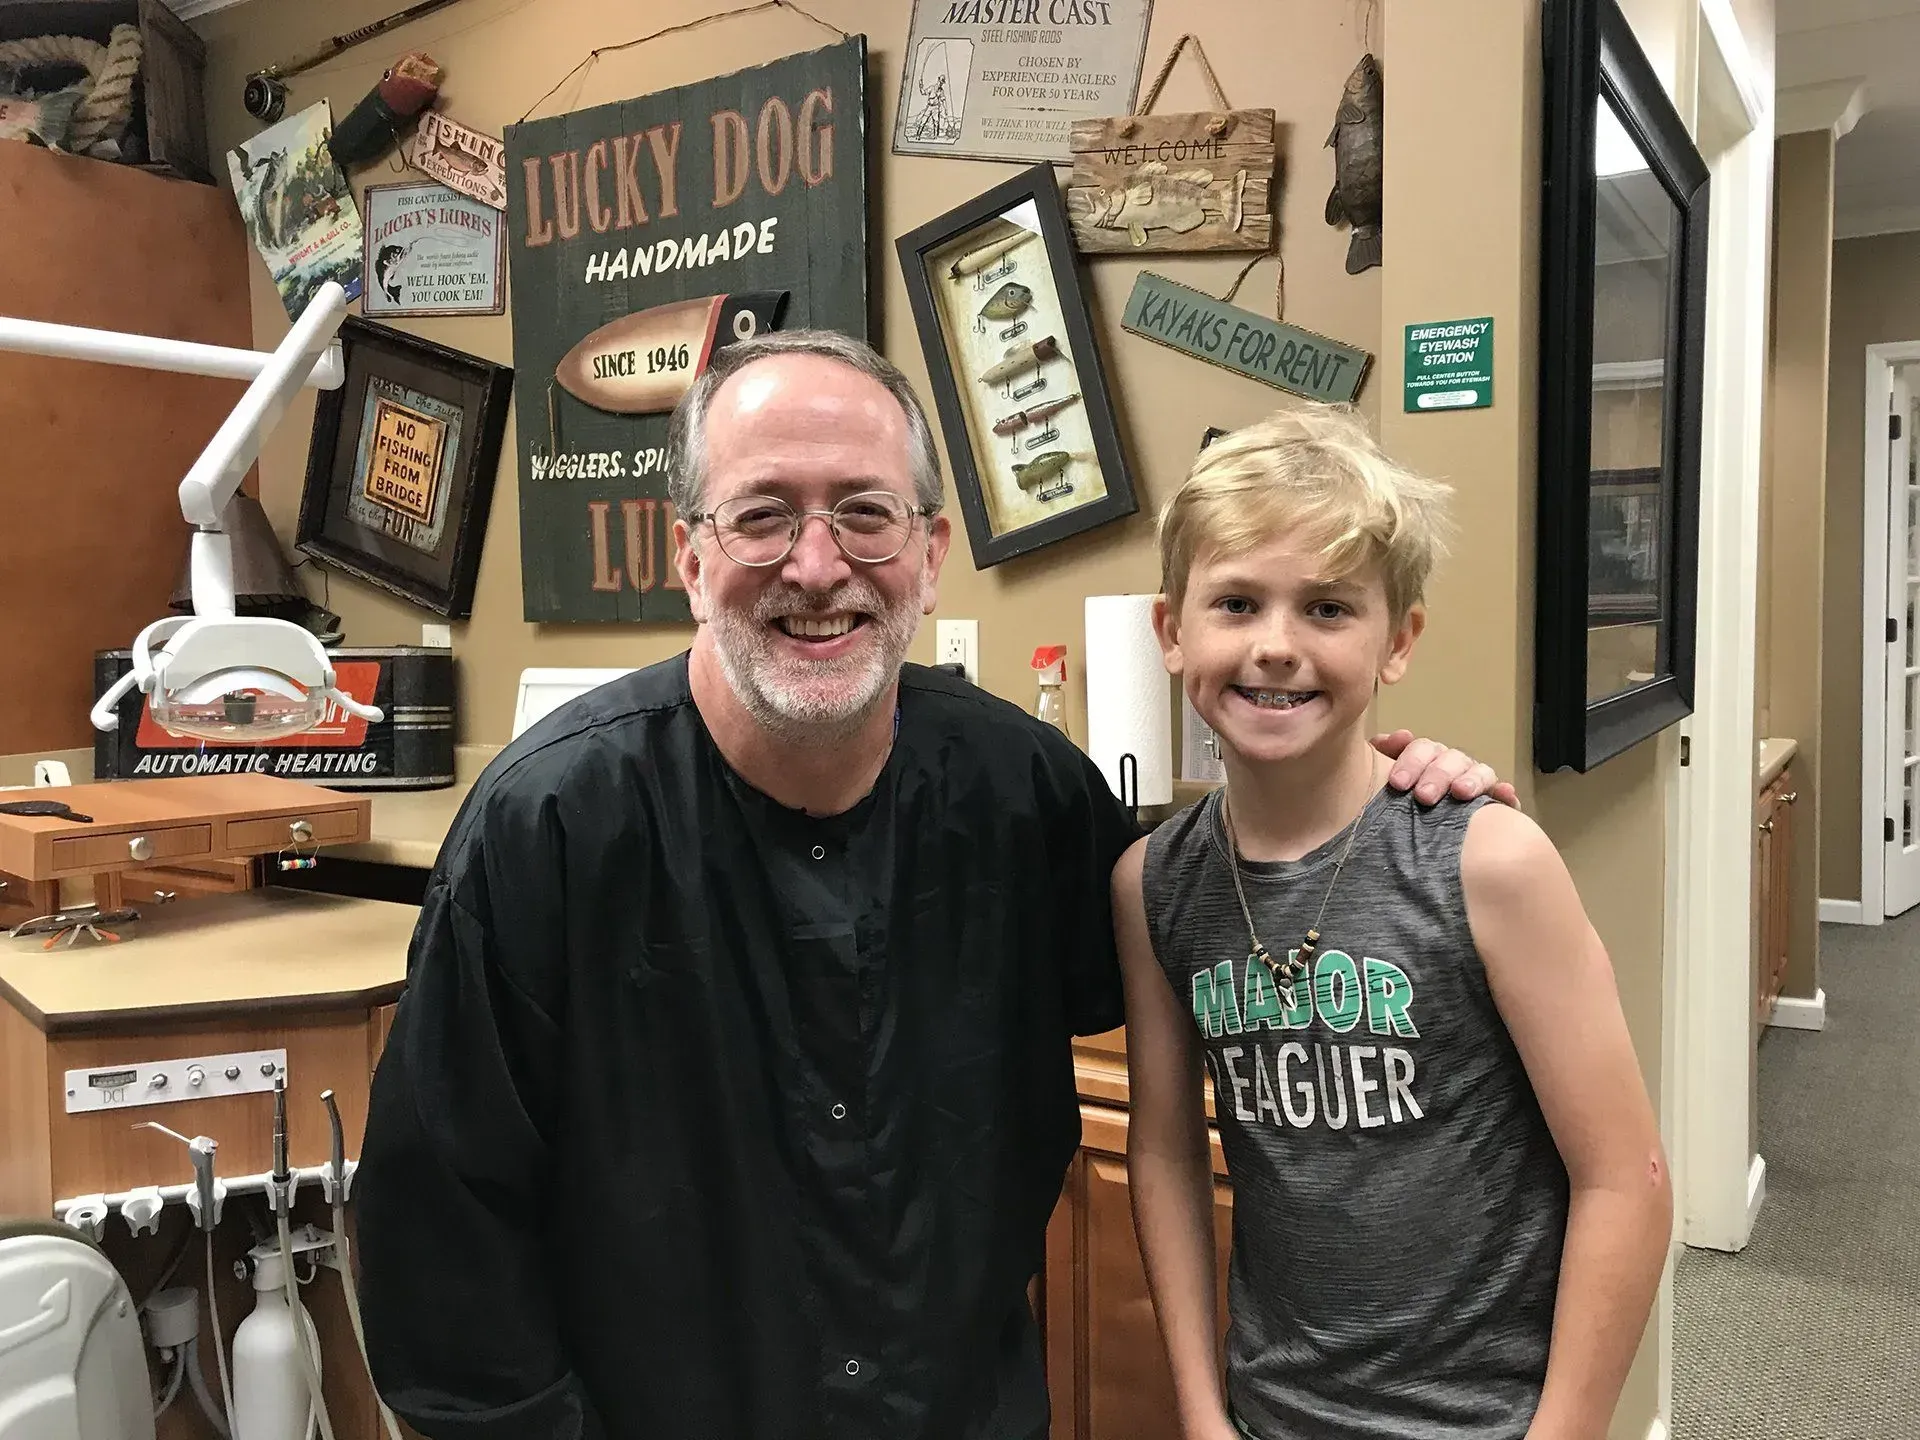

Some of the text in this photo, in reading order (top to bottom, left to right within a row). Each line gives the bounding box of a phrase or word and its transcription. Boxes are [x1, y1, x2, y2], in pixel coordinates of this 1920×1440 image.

[941, 0, 1112, 26] MASTER CAST
[981, 30, 1062, 44] STEEL FISHING RODS
[1018, 56, 1082, 68] CHOSEN BY
[982, 70, 1117, 86] EXPERIENCED ANGLERS
[992, 86, 1100, 101] FOR OVER 50 YEARS
[981, 118, 1067, 130] WE THINK YOU WILL
[983, 130, 1006, 140] WITH
[1006, 130, 1034, 140] THEIR
[1103, 138, 1228, 166] WELCOME
[426, 159, 488, 196] EXPEDITIONS
[522, 86, 836, 248] LUCKY DOG
[398, 196, 414, 206] FISH
[415, 194, 436, 204] CAN'T
[374, 208, 491, 244] LUCKY'S LURES
[288, 244, 313, 264] WRIGHT
[314, 242, 319, 250] &
[584, 216, 778, 284] HANDMADE
[407, 274, 434, 287] WE'LL
[438, 274, 466, 286] HOOK
[412, 290, 483, 302] YOU COOK 'EM!
[1136, 289, 1349, 392] KAYAKS FOR RENT
[1410, 323, 1489, 340] EMERGENCY
[1419, 338, 1480, 353] EYEWASH
[592, 344, 690, 380] SINCE 1946
[1423, 351, 1474, 366] STATION
[1406, 380, 1434, 388] TOWARDS
[1462, 376, 1491, 384] EYEWASH
[1432, 372, 1456, 380] CENTER
[1456, 370, 1480, 378] BUTTON
[396, 420, 416, 441] NO
[379, 436, 432, 467] FISHING
[384, 458, 420, 485] FROM
[532, 450, 626, 480] WIGGLERS,
[376, 476, 423, 508] BRIDGE
[382, 508, 416, 543] FUN
[134, 752, 378, 774] AUTOMATIC HEATING
[1192, 948, 1421, 1040] MAJOR
[103, 1088, 126, 1104] DCI
[1207, 1042, 1425, 1130] EAGUER
